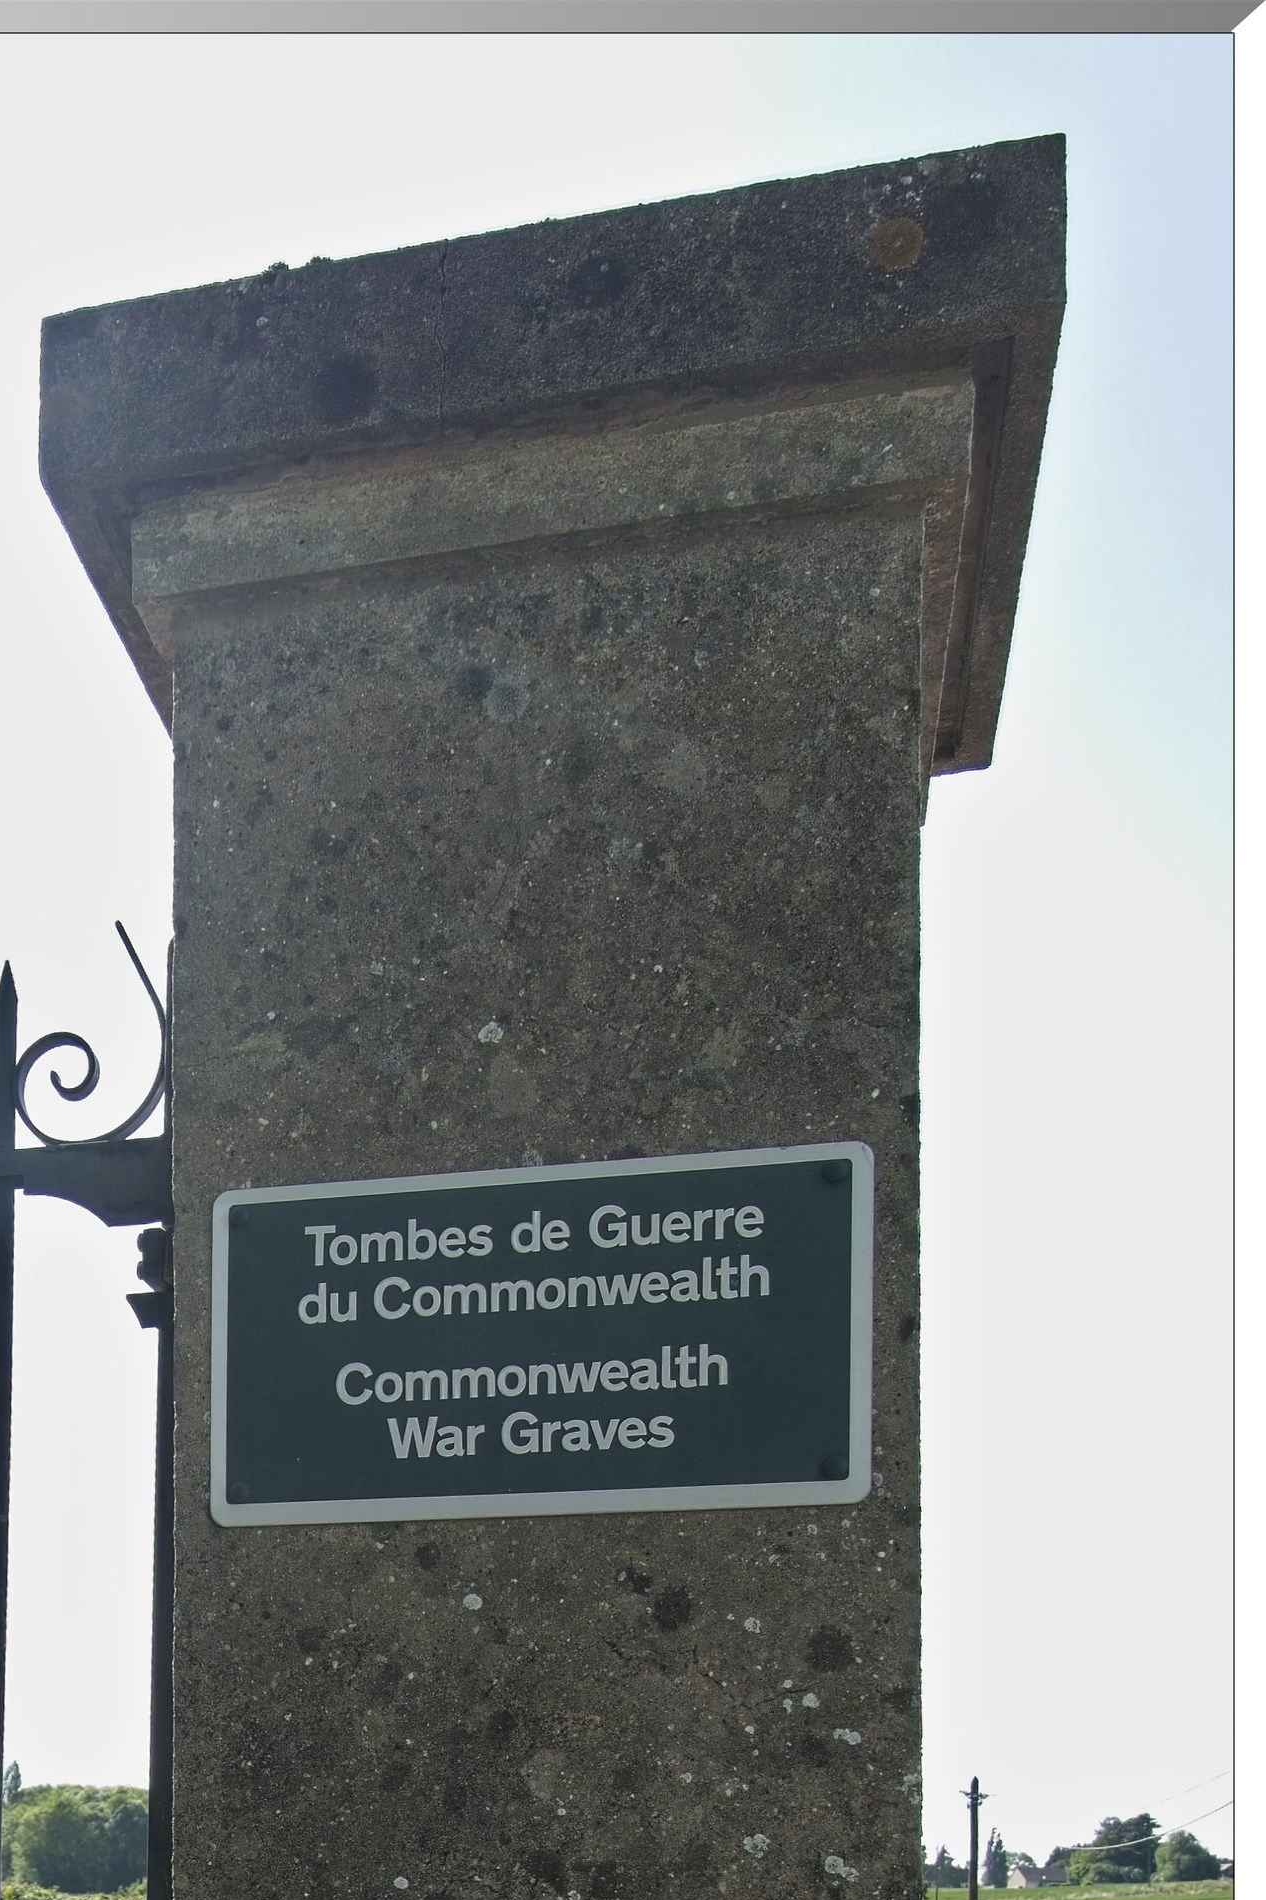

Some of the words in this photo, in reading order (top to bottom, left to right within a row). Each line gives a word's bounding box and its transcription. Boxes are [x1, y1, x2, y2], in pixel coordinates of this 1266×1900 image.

[304, 1218, 494, 1267] Tombes
[510, 1210, 571, 1254] de
[588, 1204, 765, 1249] Guerre
[297, 1282, 358, 1325] du
[373, 1254, 770, 1320] Commonwealth
[335, 1343, 729, 1406] Commonwealth
[386, 1415, 486, 1459] War
[501, 1411, 675, 1455] Graves
